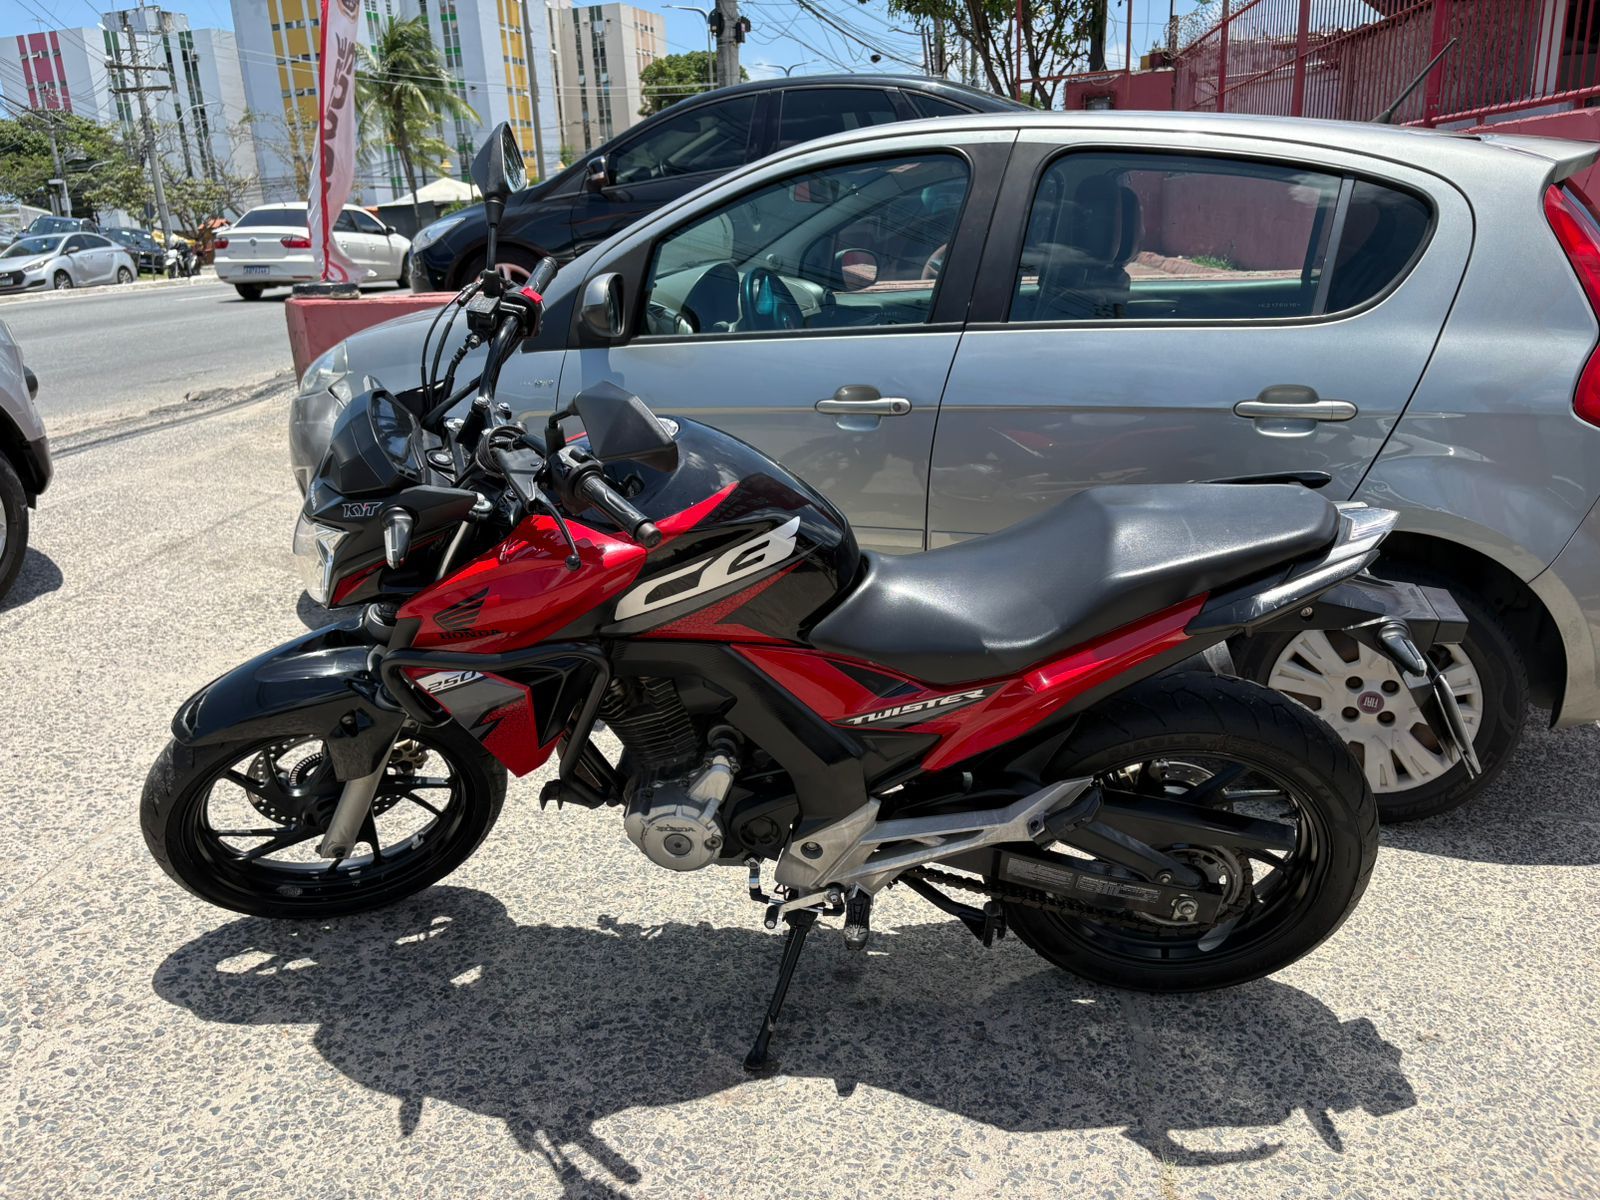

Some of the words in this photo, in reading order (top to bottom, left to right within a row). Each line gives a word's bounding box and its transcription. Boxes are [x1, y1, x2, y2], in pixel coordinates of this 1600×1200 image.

[342, 501, 384, 518] KYT
[614, 515, 801, 621] CB
[427, 670, 477, 692] 250
[846, 689, 987, 725] TWISTER
[1363, 696, 1379, 708] FIAT
